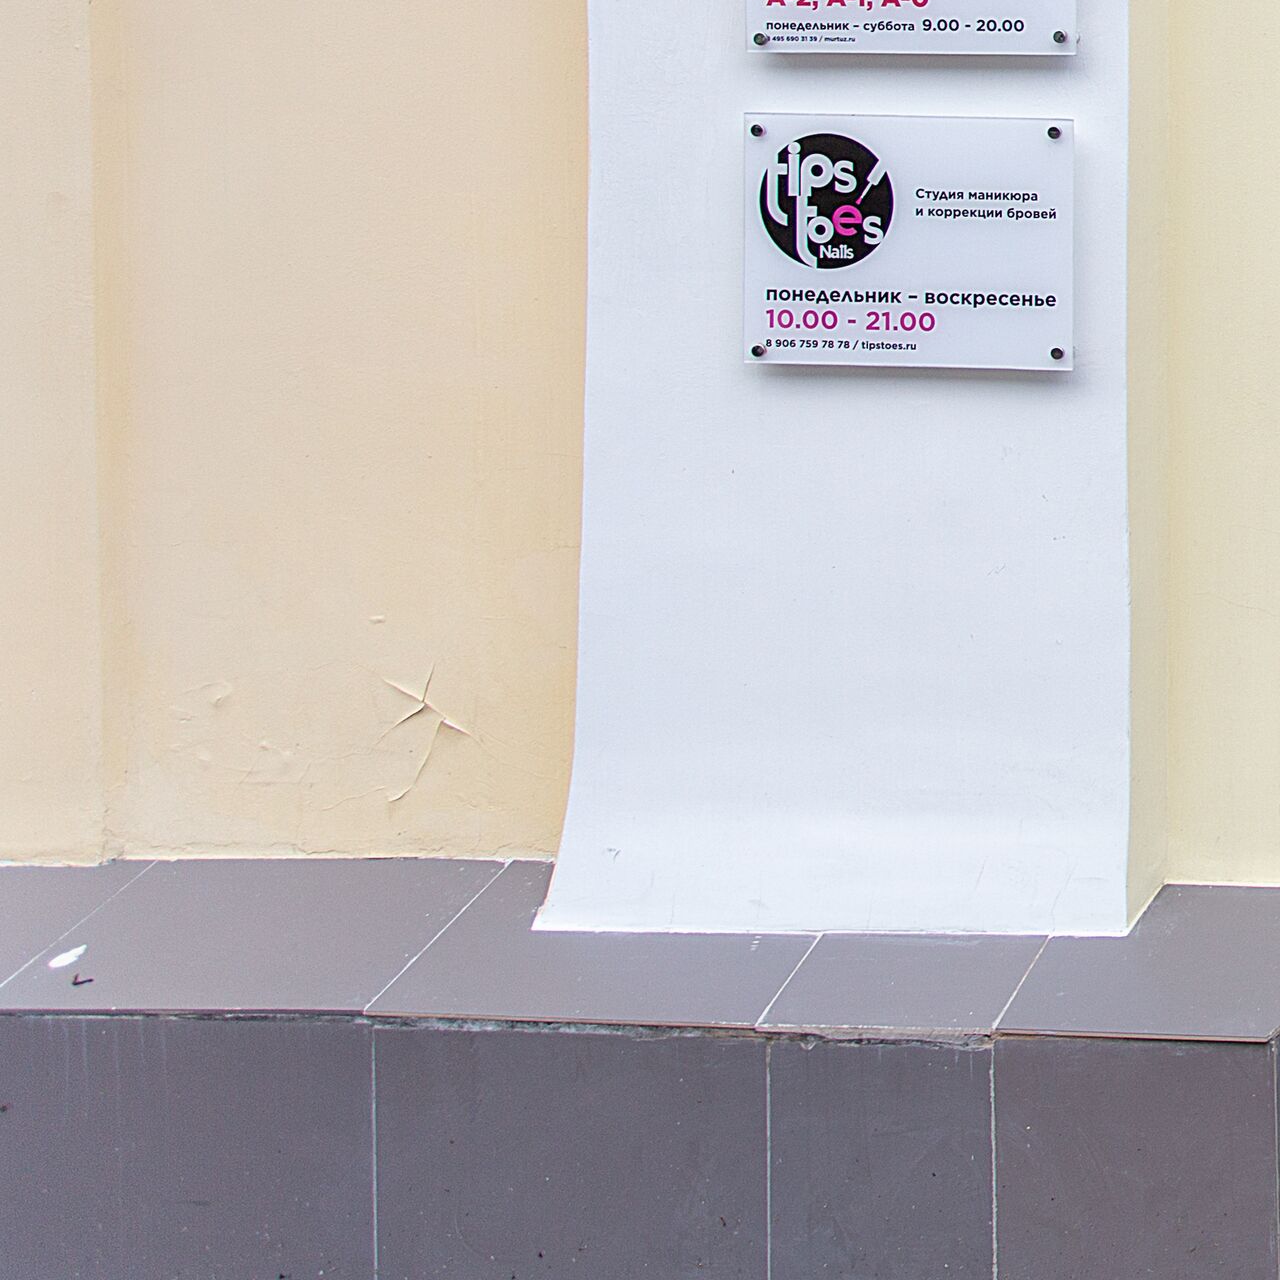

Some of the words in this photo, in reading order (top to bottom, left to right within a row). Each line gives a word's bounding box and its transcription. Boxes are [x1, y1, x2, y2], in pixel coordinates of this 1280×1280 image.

[766, 21, 849, 32] понедельник
[863, 20, 915, 32] суббота
[922, 19, 959, 32] 9.00
[976, 20, 1025, 32] 20.00
[915, 188, 964, 201] Студия
[968, 190, 1038, 203] маникюра
[927, 208, 1003, 219] коррекции
[1007, 208, 1057, 220] бровей
[819, 245, 854, 259] Nails
[766, 288, 901, 304] понедельник
[924, 293, 1057, 308] воскресенье
[766, 309, 838, 330] 10.00
[866, 311, 935, 331] 21.00
[766, 339, 772, 347] 8
[775, 339, 797, 347] 906
[800, 340, 819, 348] 759
[822, 340, 835, 348] 78
[838, 340, 850, 349] 78
[861, 340, 917, 351] tipstoes.ru
